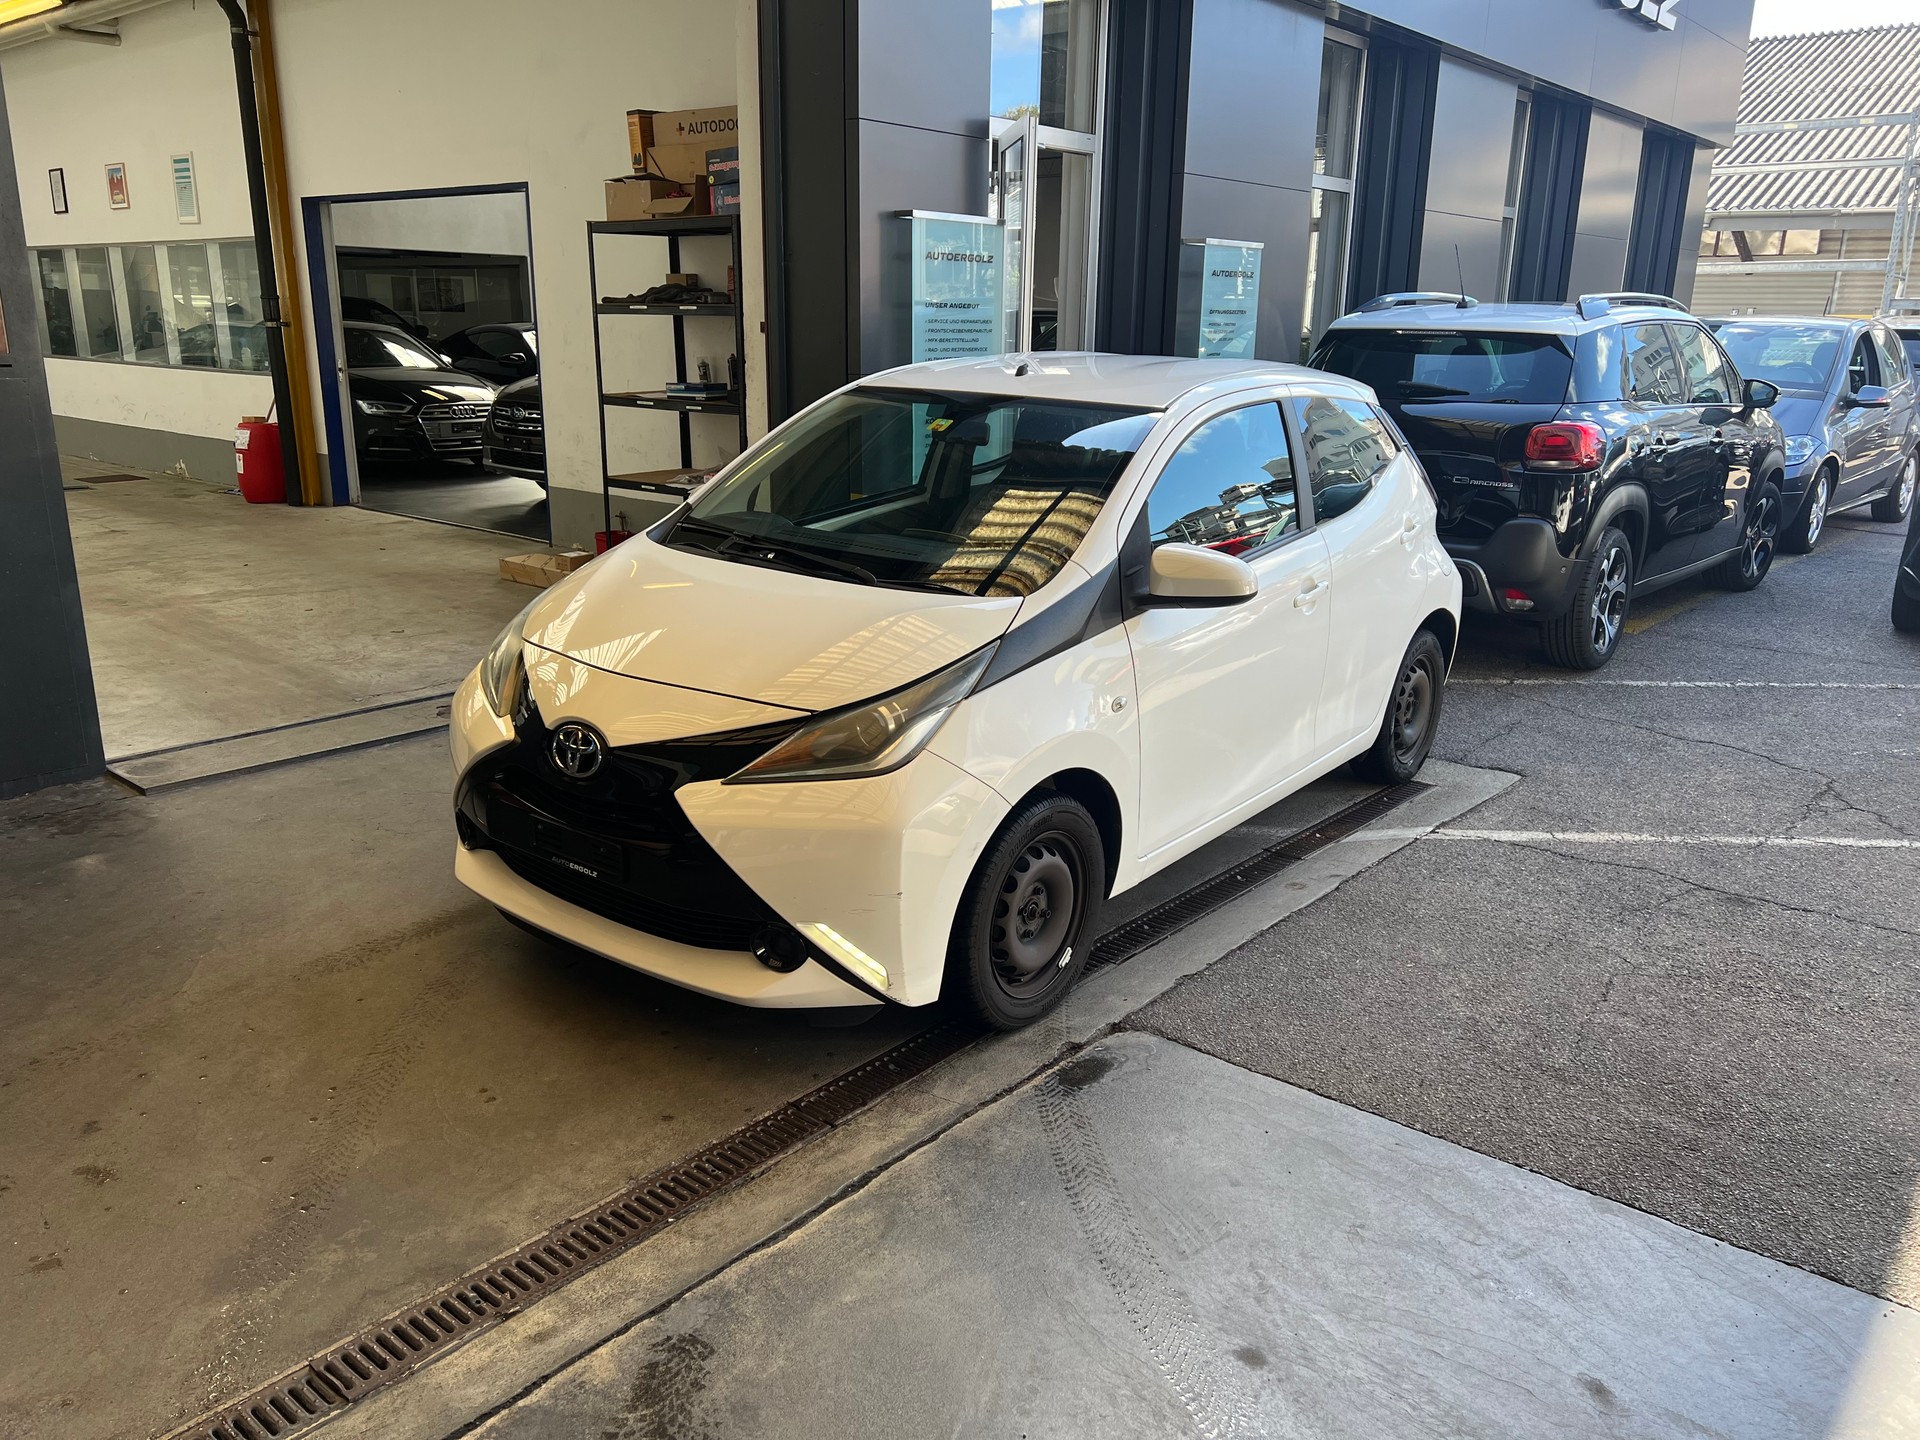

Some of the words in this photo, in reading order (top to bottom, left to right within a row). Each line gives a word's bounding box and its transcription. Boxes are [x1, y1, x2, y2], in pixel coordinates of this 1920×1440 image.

[925, 251, 994, 264] AUTOERGOLZ
[1212, 270, 1255, 279] AUTOERGOLZ
[1470, 480, 1514, 488] AIRCROSS
[551, 856, 598, 878] AUTOERGOLZ
